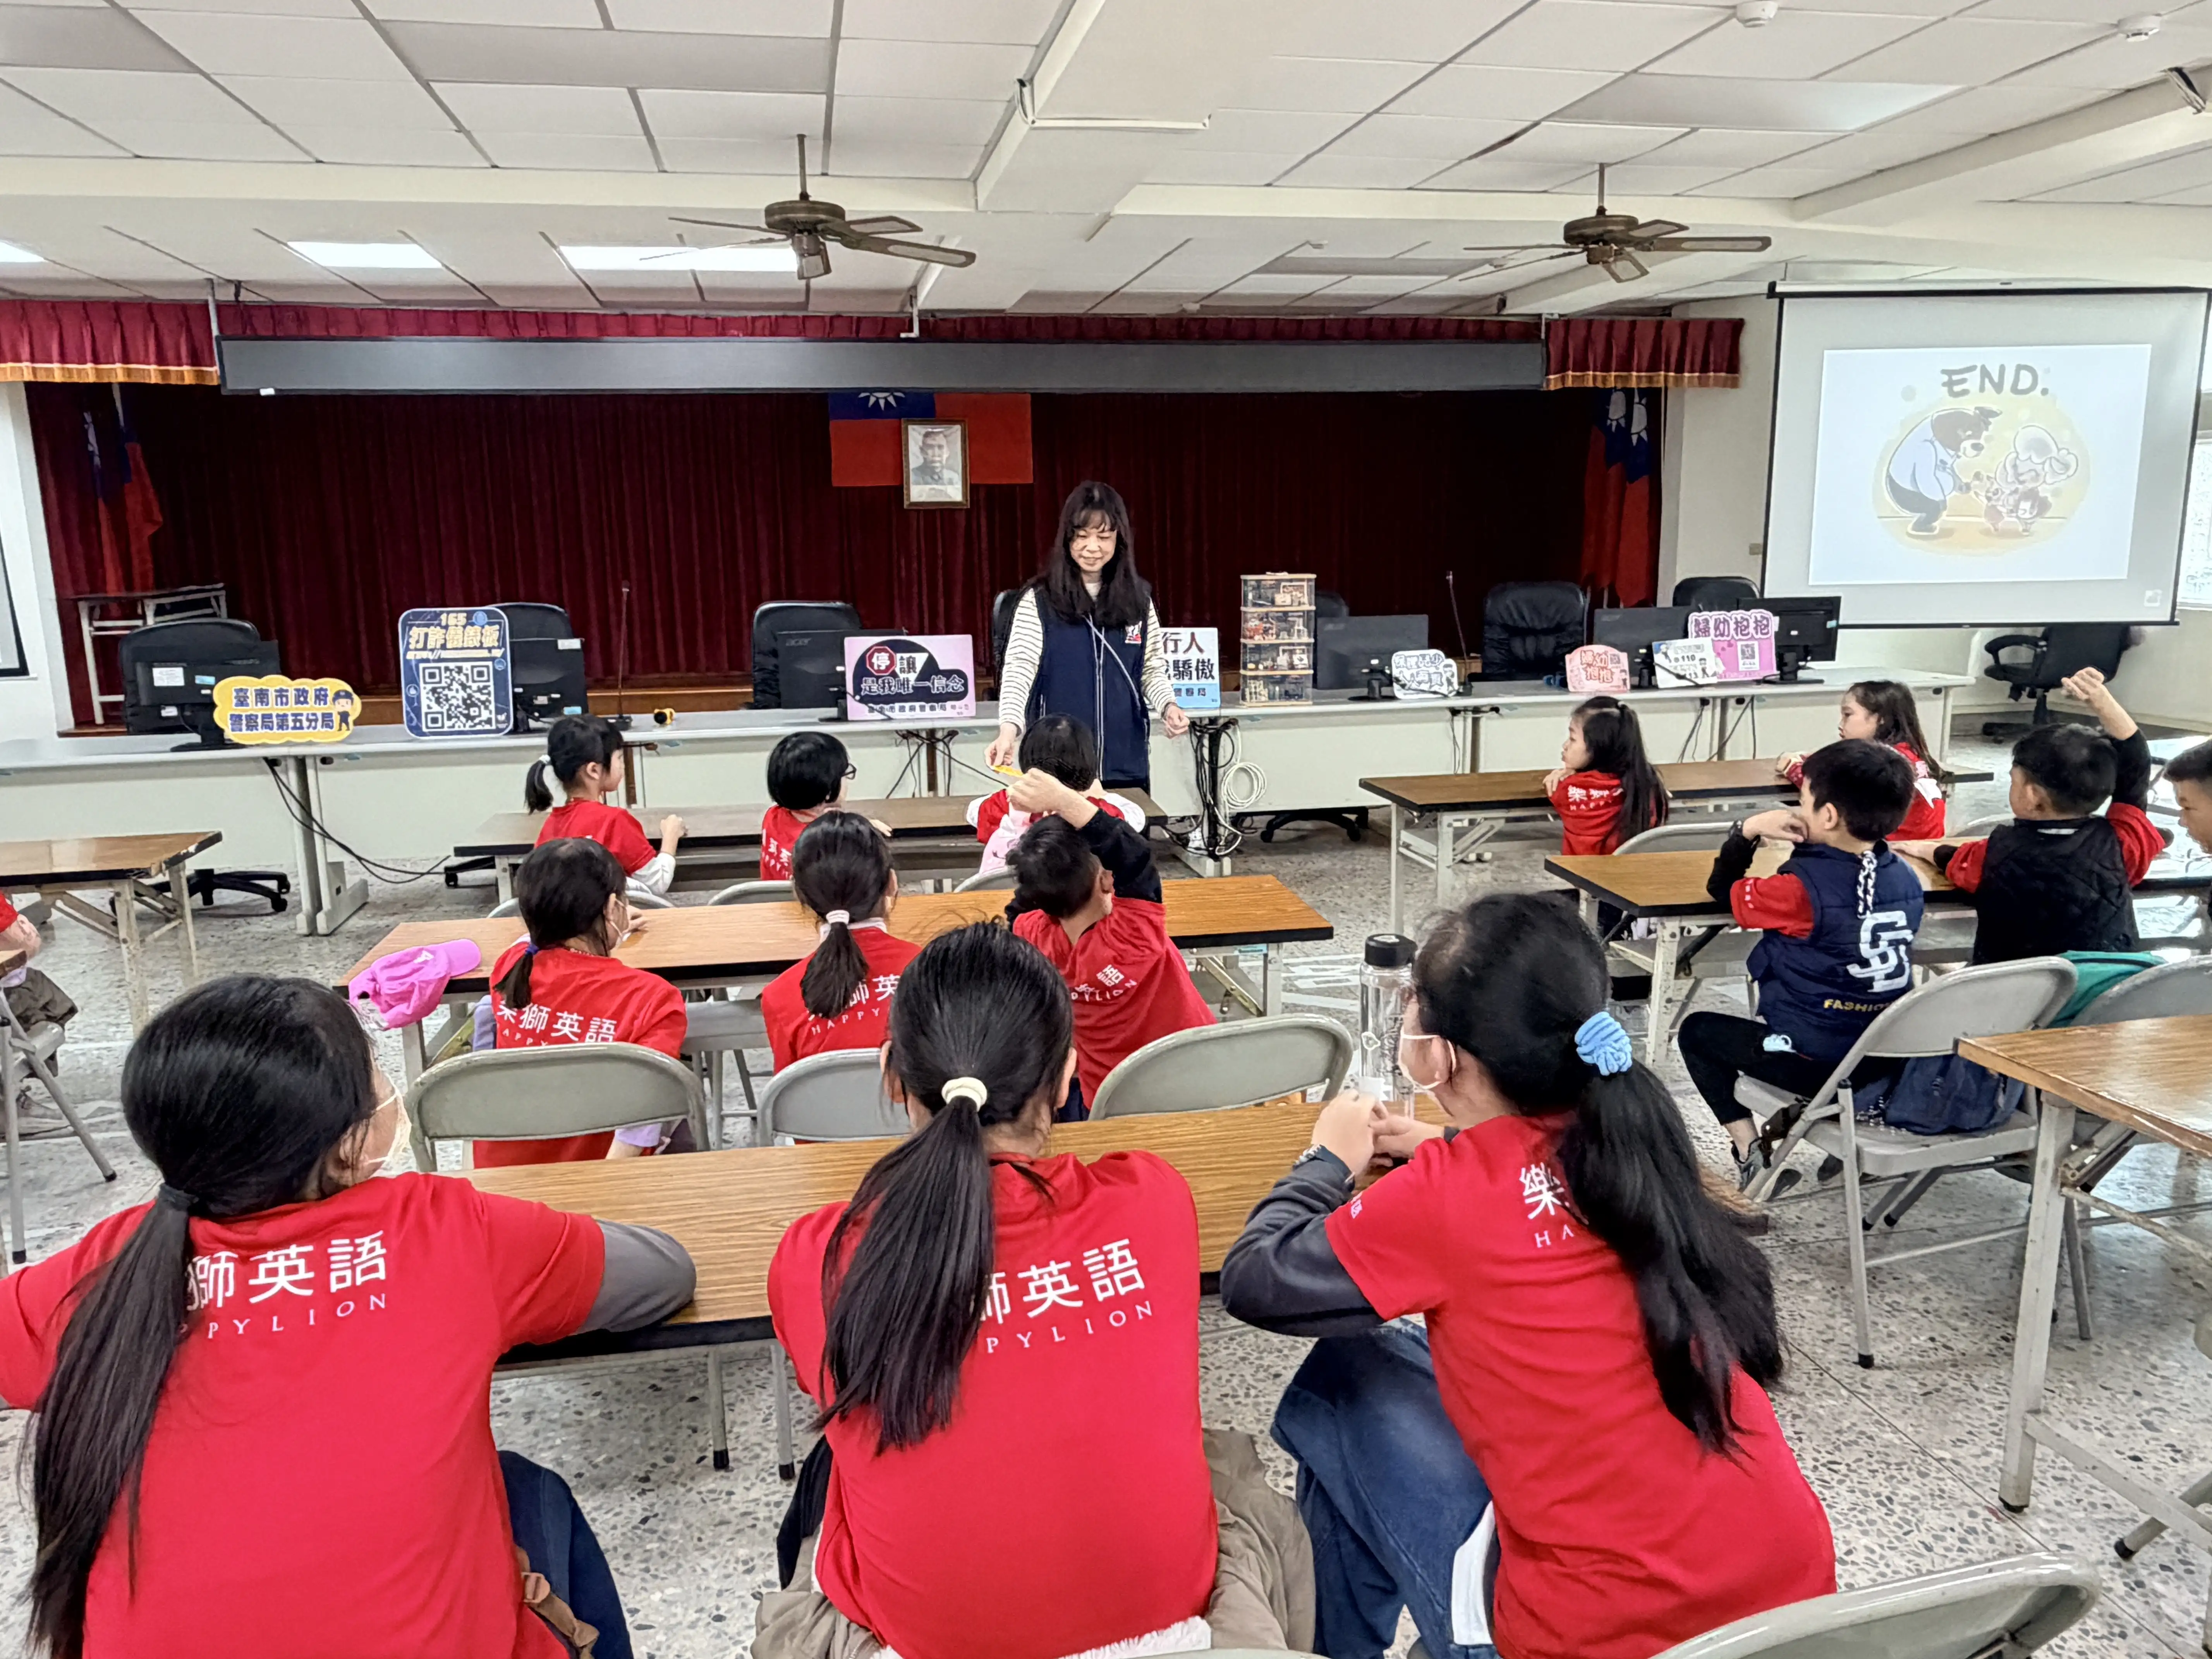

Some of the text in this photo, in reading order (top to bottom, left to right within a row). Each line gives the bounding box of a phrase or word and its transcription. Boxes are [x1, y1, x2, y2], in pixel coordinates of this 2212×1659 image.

[1941, 364, 2048, 398] END.
[1694, 615, 1770, 638] 婦幼抱抱
[1162, 632, 1204, 654] 行人
[1165, 658, 1215, 680] 驕傲
[860, 674, 964, 695] 是我唯一信念
[234, 687, 328, 707] 臺南市政府
[230, 712, 334, 732] 警察局第五分局
[1824, 999, 1890, 1012] FASHIO
[811, 1008, 879, 1035] HAPPY
[986, 1301, 1152, 1353] PYLION
